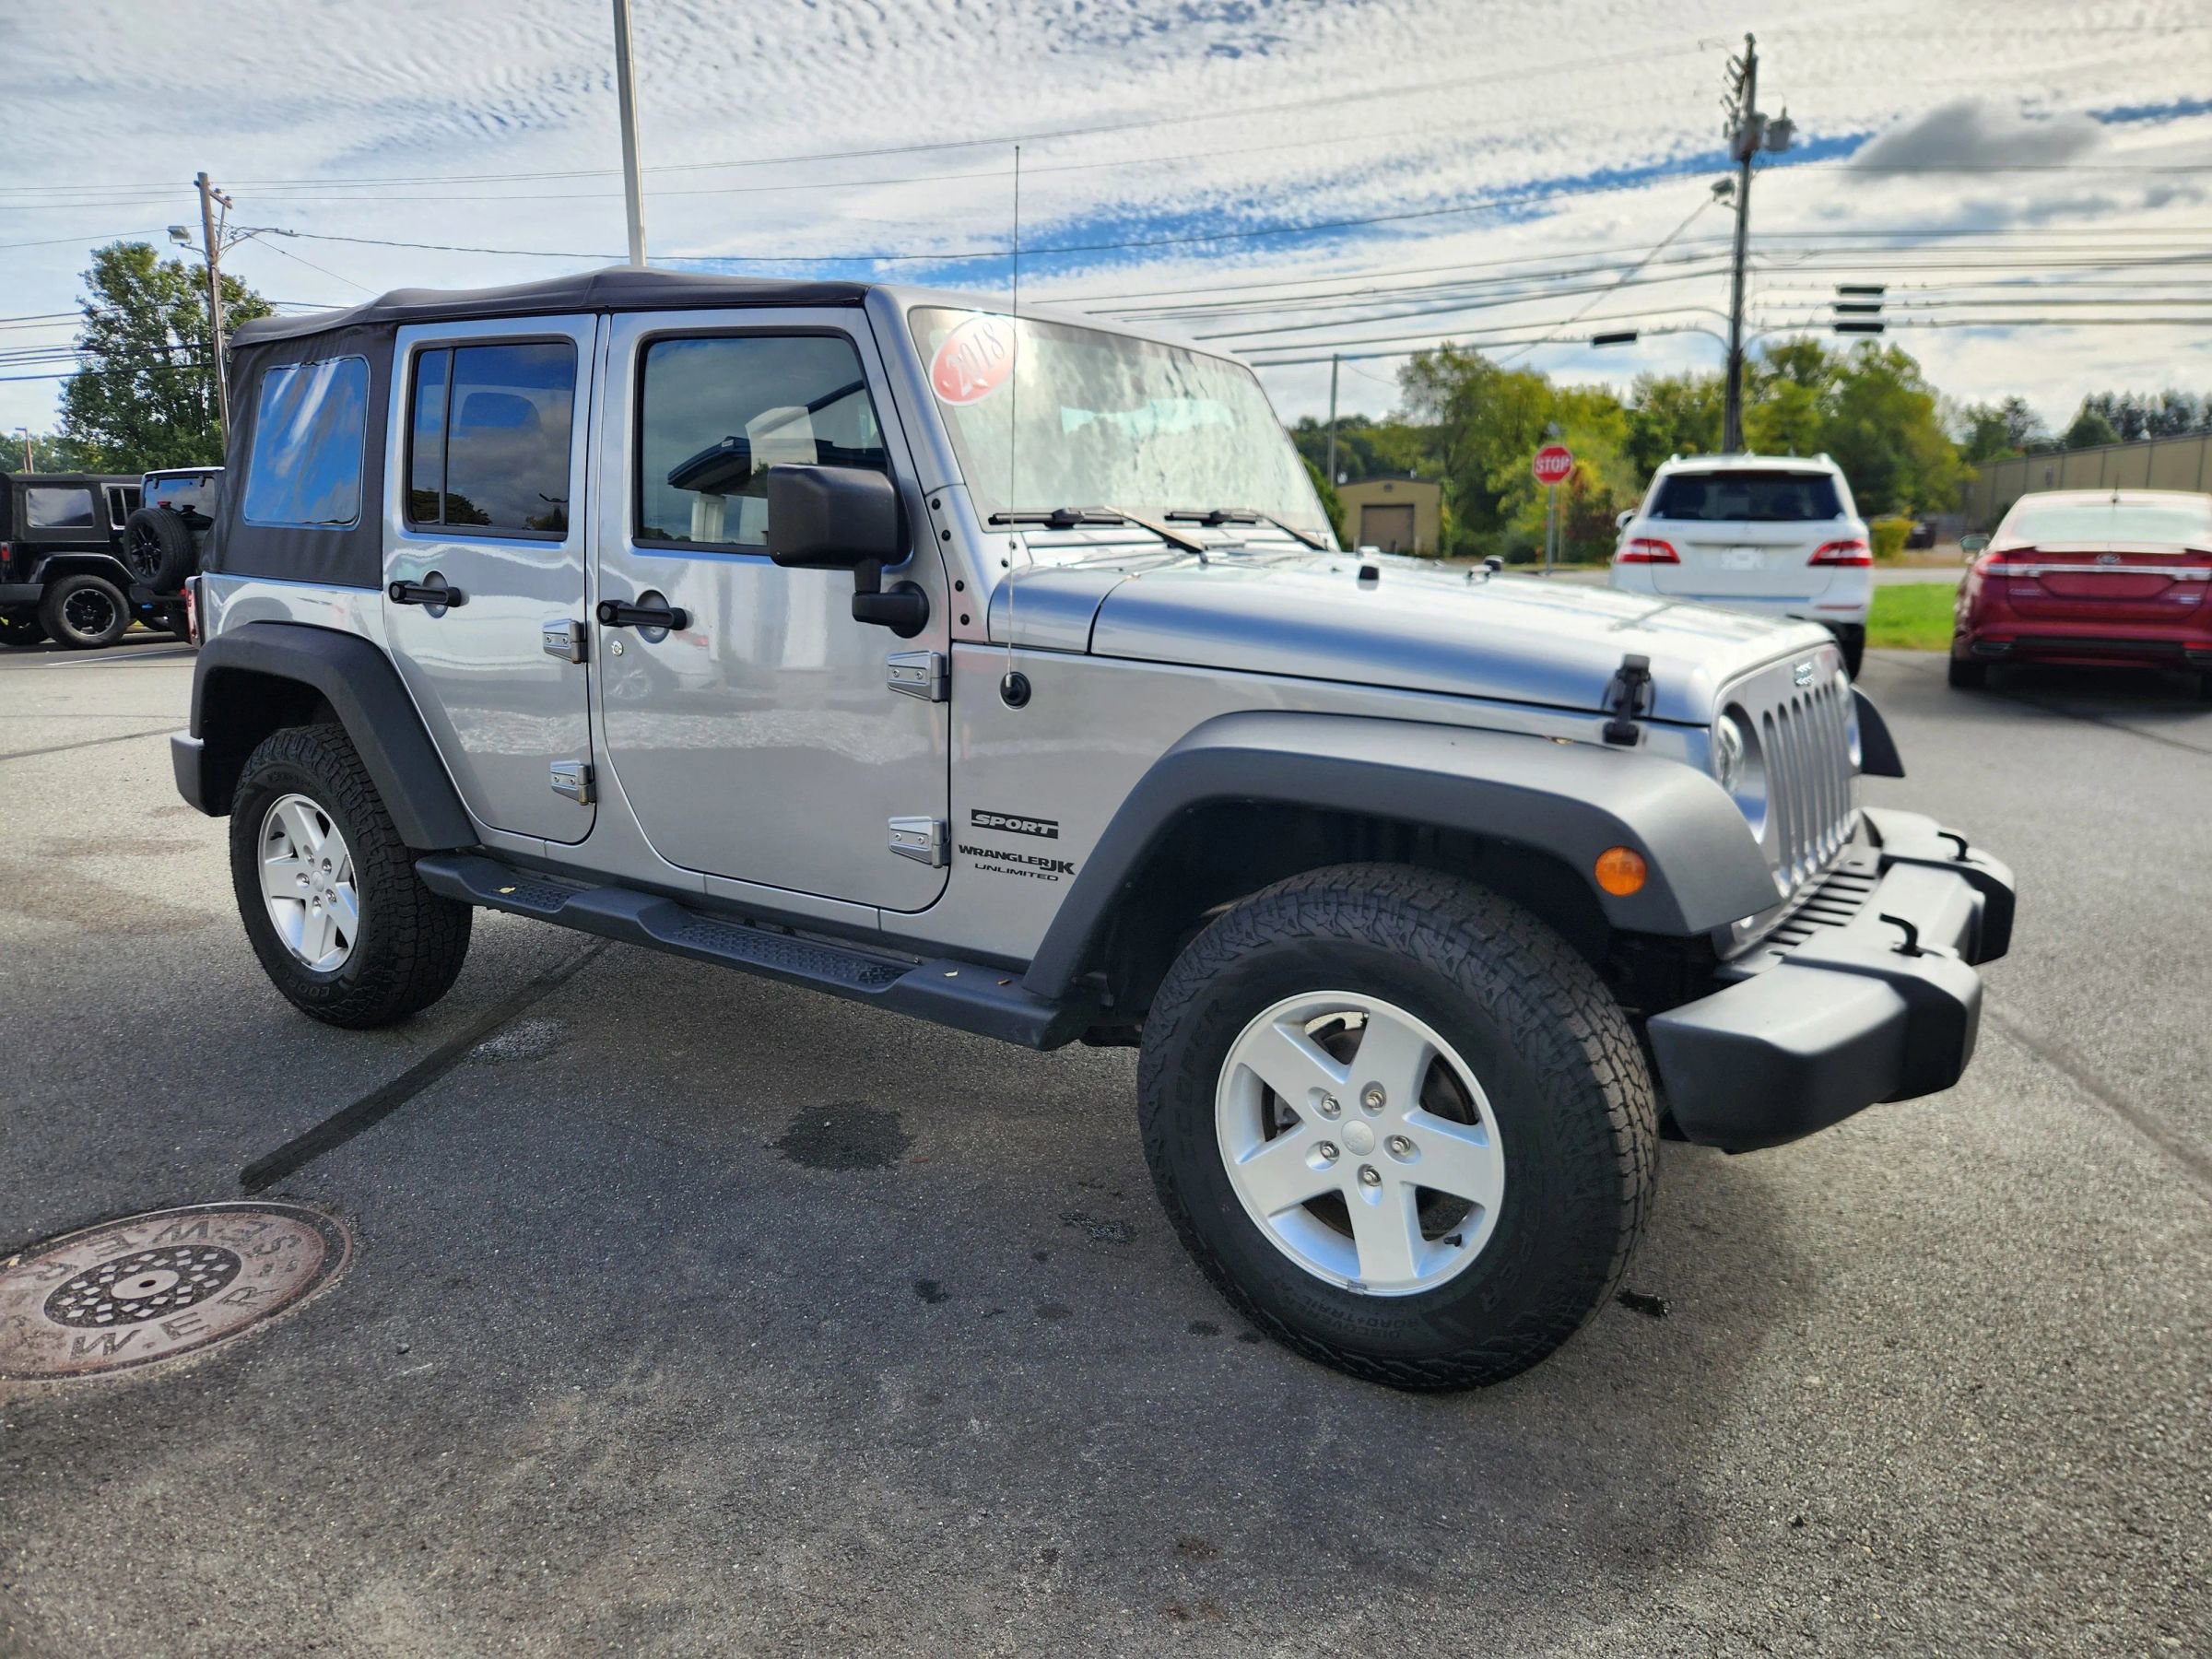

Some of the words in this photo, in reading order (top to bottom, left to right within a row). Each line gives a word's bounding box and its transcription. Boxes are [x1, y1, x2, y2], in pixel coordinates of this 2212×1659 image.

[946, 322, 1006, 397] 2018
[1535, 455, 1571, 473] STOP
[971, 811, 1058, 837] SPORT
[974, 863, 1059, 881] UNLIMITED
